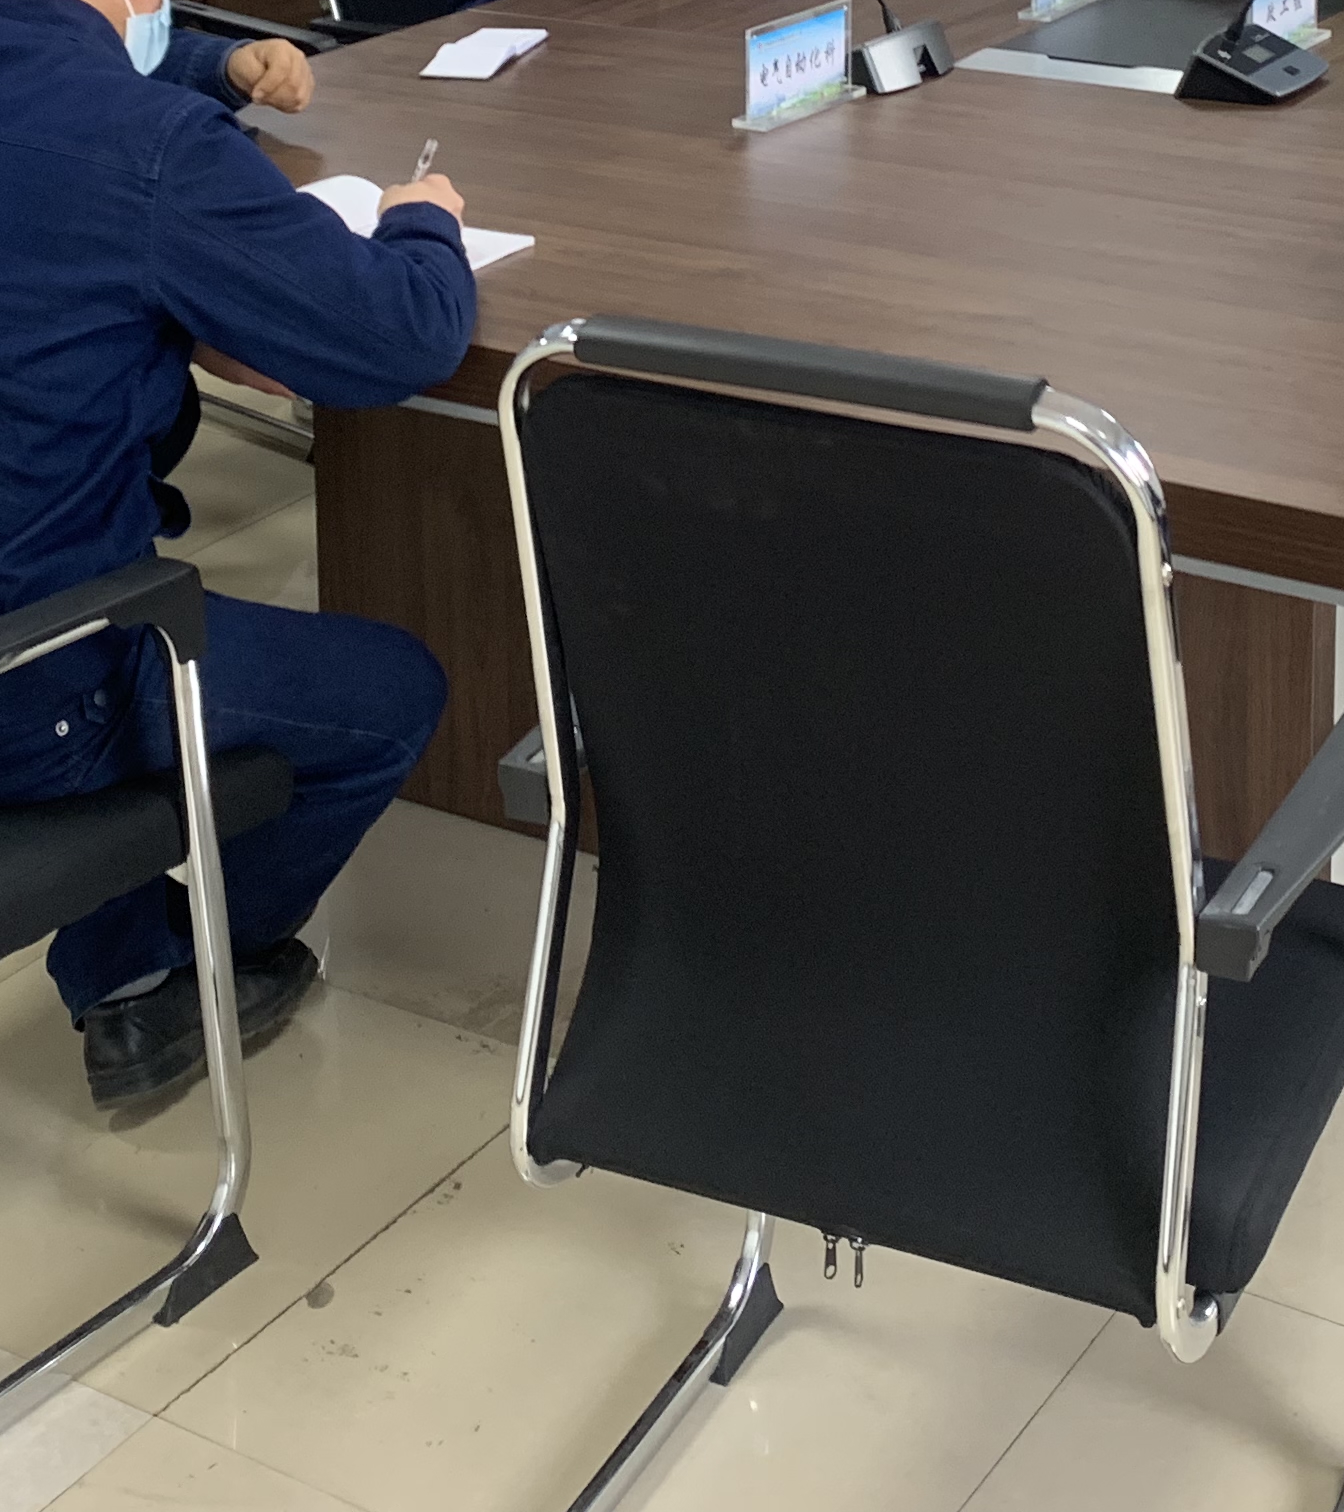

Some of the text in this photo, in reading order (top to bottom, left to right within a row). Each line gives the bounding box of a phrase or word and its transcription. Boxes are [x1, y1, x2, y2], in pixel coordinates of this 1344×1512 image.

[759, 38, 836, 87] 电气自动化科
